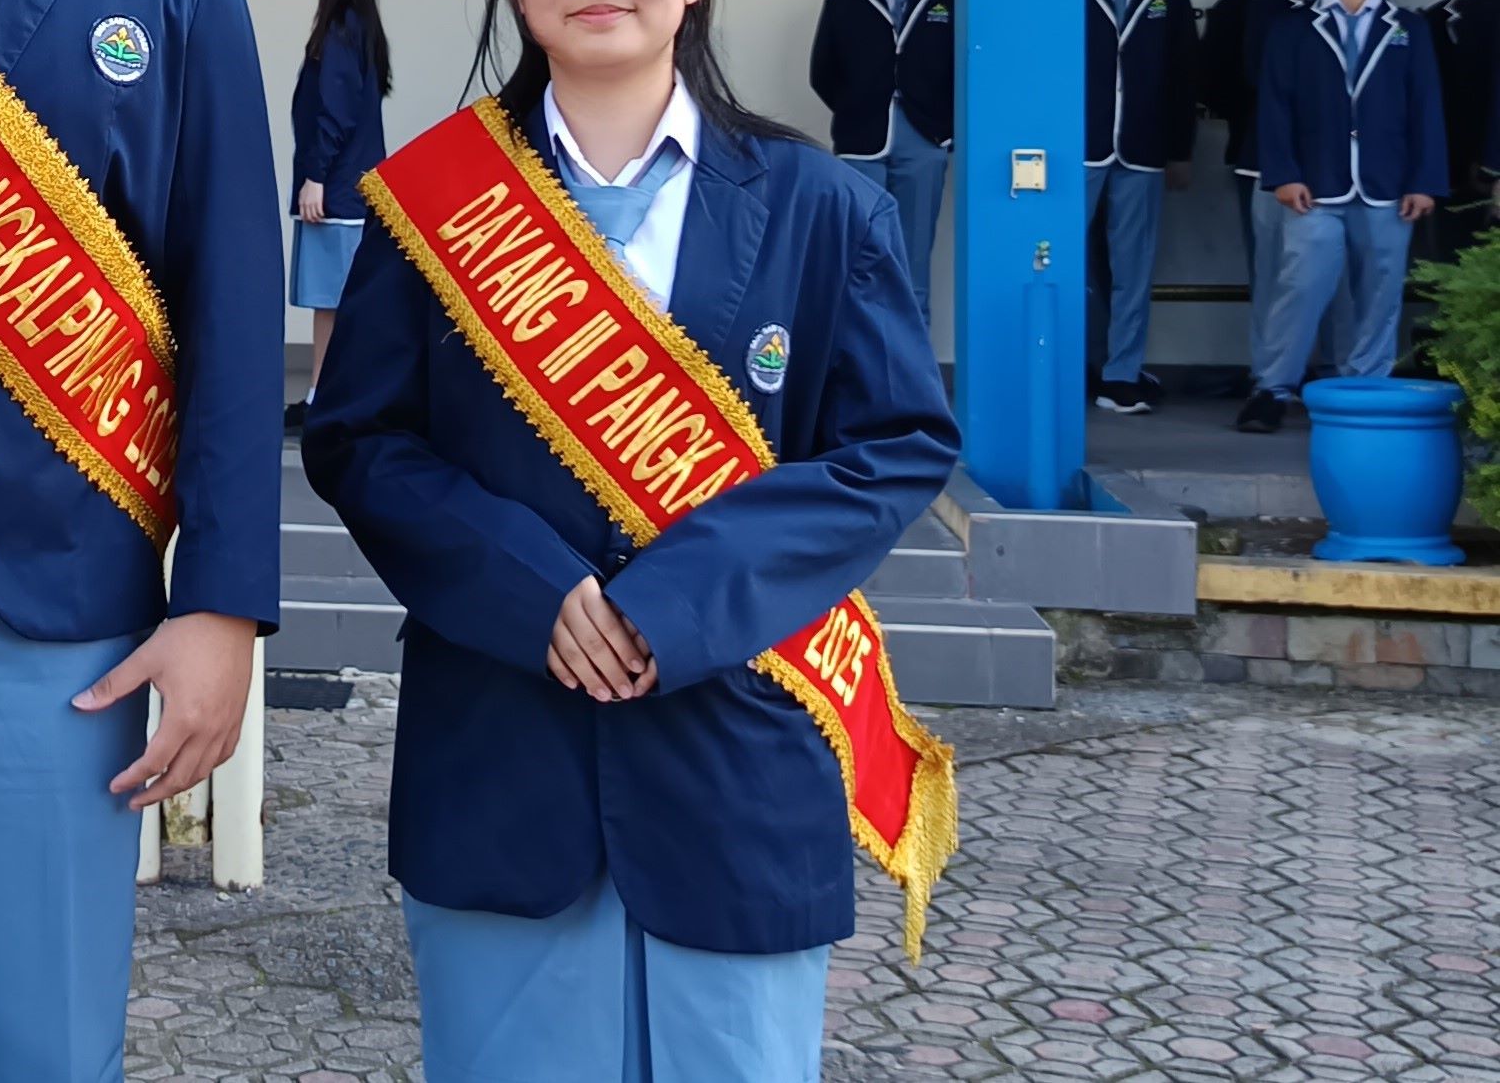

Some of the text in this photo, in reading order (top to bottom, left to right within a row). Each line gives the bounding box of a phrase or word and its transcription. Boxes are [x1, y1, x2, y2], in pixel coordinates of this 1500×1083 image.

[436, 182, 589, 343] DAYANG
[538, 309, 622, 384] III
[803, 607, 872, 707] 2025
